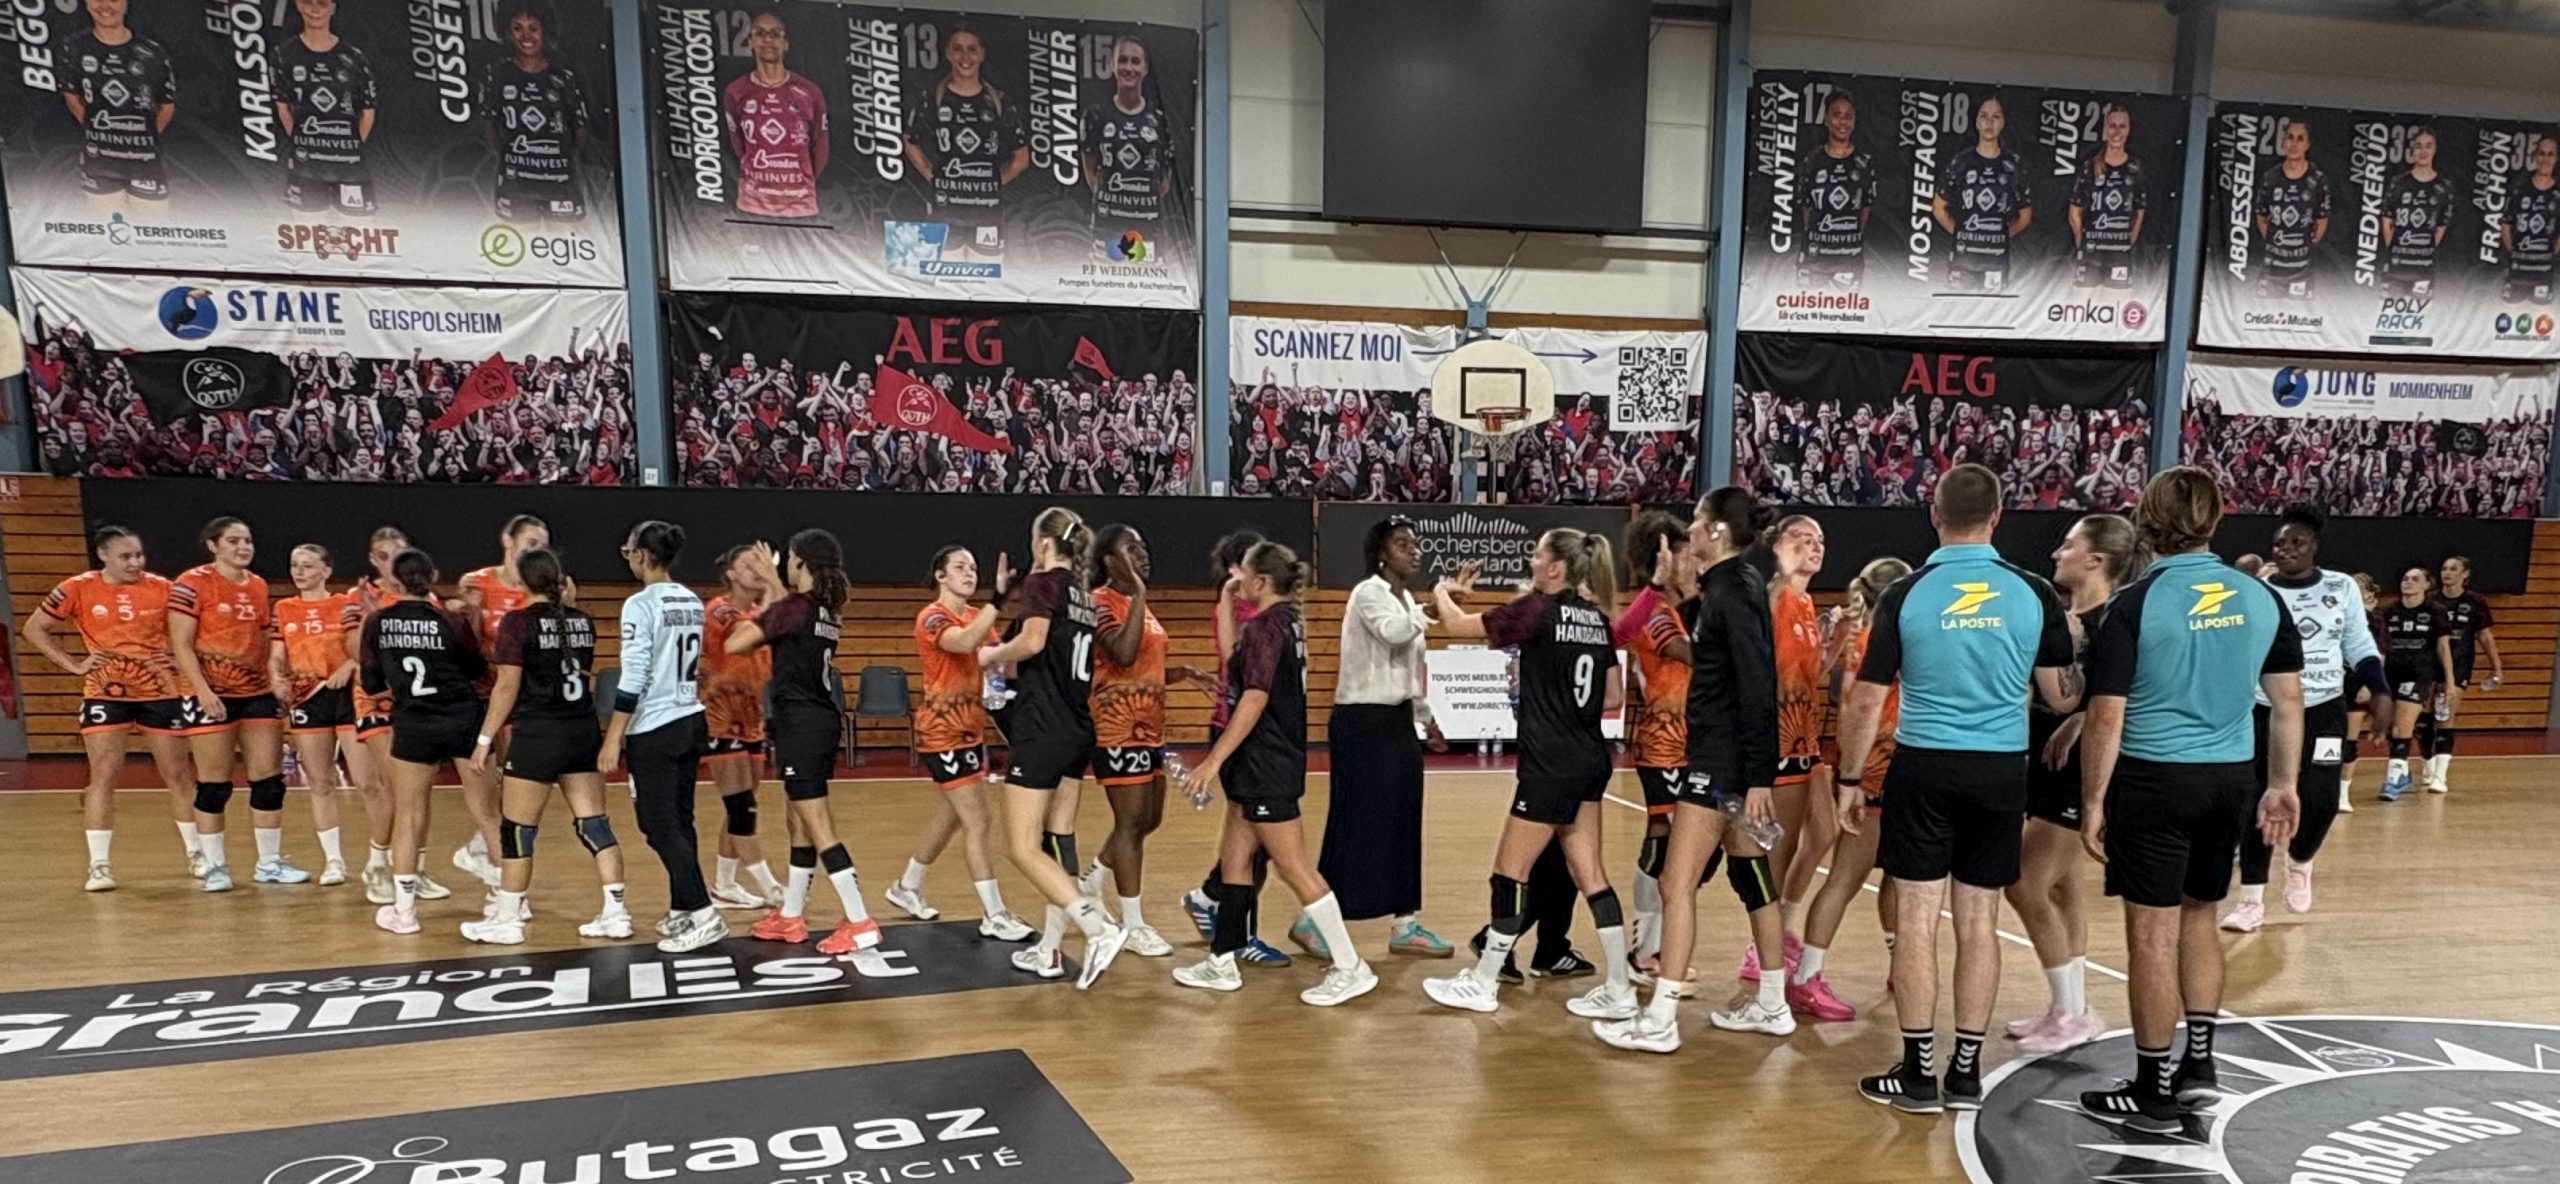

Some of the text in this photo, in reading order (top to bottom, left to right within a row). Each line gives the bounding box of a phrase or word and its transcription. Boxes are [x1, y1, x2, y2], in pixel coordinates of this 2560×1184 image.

[407, 0, 437, 82] LOUIS
[715, 10, 753, 57] 12
[903, 22, 939, 69] 13
[1080, 34, 1114, 79] 15
[231, 0, 278, 162] KARLSSO
[658, 5, 692, 160] ELIHANNAH
[846, 17, 876, 155] CHARLÈNE
[871, 19, 904, 182] GUERRIER
[1028, 29, 1051, 168] CORENTINE
[1803, 82, 1832, 124] 17
[1051, 30, 1080, 186] CAVALIER
[1899, 90, 1917, 148] YOSR
[1942, 93, 1969, 134] 18
[2040, 100, 2058, 146] LISA
[2054, 101, 2080, 176] VLUG
[2220, 113, 2237, 191] DALILA
[2350, 123, 2370, 184] NORA
[935, 178, 998, 192] EURINVEST
[1770, 82, 1800, 253] CHANTELLY
[1908, 91, 1940, 282] MOSTEFAOUI
[2473, 128, 2494, 210] ALBANE
[2228, 114, 2258, 281] ABDESSELAM
[2355, 122, 2389, 288] SNEDKERUD
[2480, 131, 2512, 264] FRACHON
[45, 222, 105, 235] PIERRES
[133, 225, 226, 240] TERRITOIRES
[531, 231, 597, 266] egis
[925, 261, 994, 277] Univer
[1099, 266, 1168, 278] WEIDMANN
[227, 290, 502, 333] STANE GEISPOLSHEIM
[1776, 291, 1870, 310] cuisinella
[2048, 298, 2114, 324] emka
[2244, 312, 2323, 327] Crédit Mutuel
[2376, 314, 2424, 330] RACK
[2382, 297, 2431, 314] POLY
[885, 316, 1004, 367] AEG
[1254, 329, 1401, 362] SCANNEZ MOI
[1901, 353, 1996, 398] AEG
[2314, 370, 2473, 400] JUNG MOMMENHEIM
[118, 605, 134, 621] 5
[303, 620, 323, 635] 15
[381, 618, 438, 634] PIRATHS
[1941, 617, 2002, 630] LA POSTE
[2189, 615, 2244, 631] LA POSTE
[379, 634, 445, 651] HANDBALL
[677, 633, 700, 682] 12
[402, 656, 438, 697] 2
[1431, 674, 1453, 682] TOUS
[1574, 654, 1594, 708] 9
[90, 705, 107, 723] 5
[290, 709, 308, 725] 15
[966, 751, 979, 770] 9
[1126, 751, 1150, 773] 29
[112, 965, 533, 1010] La Région
[629, 949, 920, 999] Est
